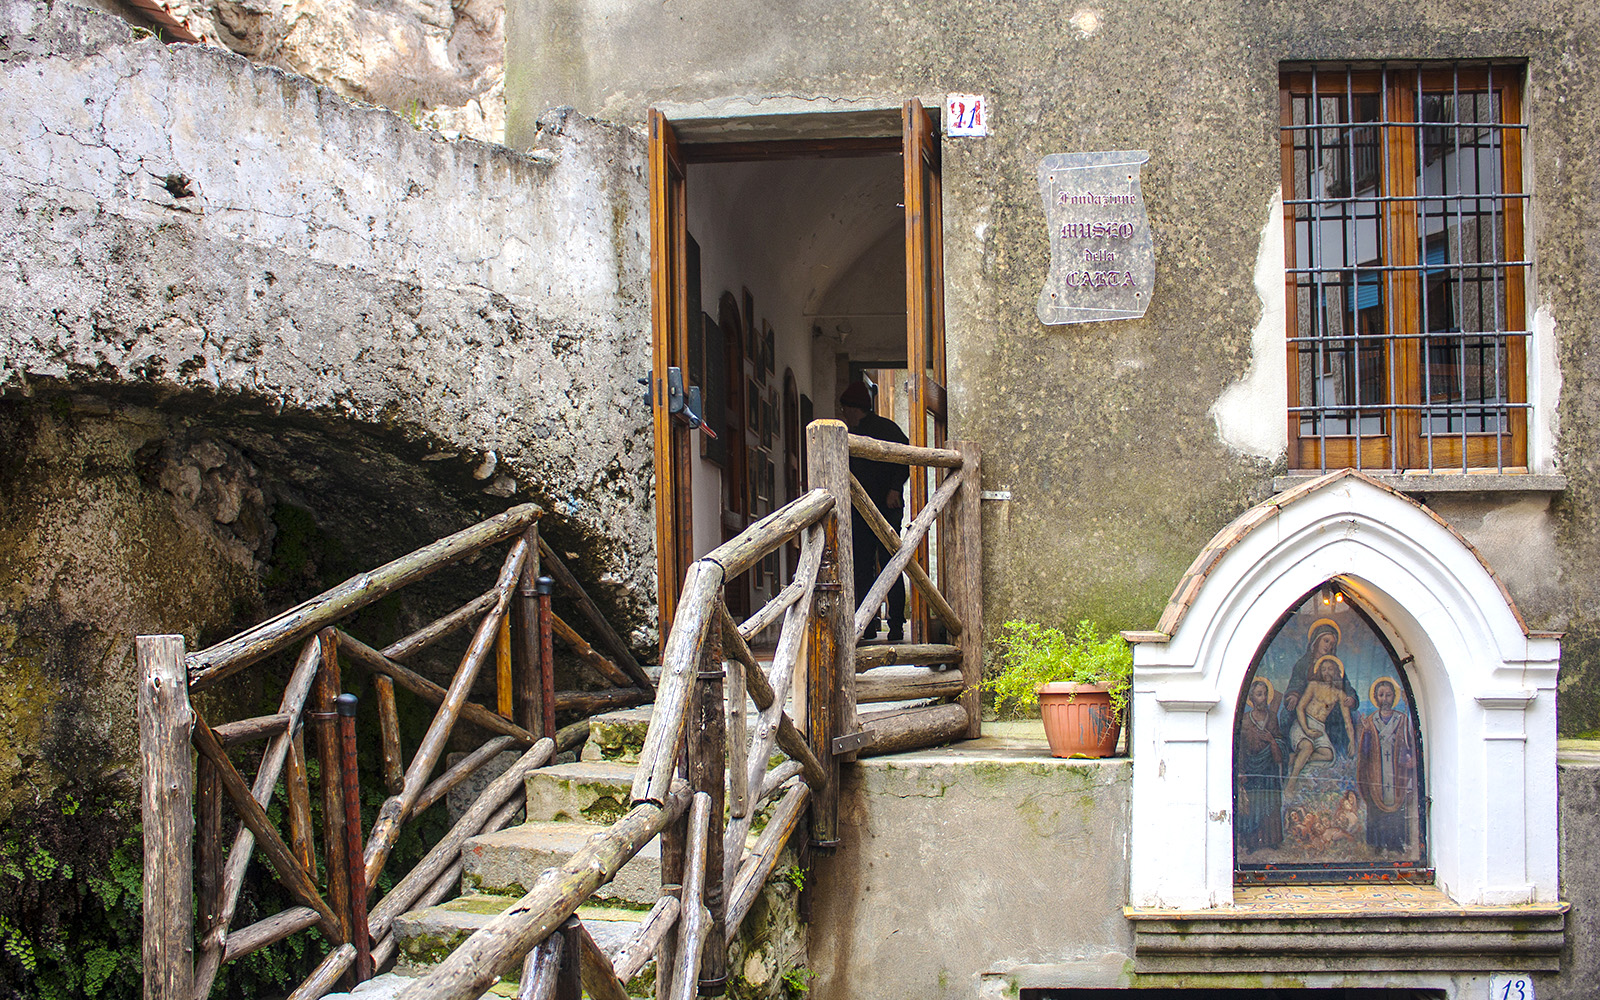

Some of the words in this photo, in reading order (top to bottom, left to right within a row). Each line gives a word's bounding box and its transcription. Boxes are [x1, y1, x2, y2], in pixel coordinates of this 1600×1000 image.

[1056, 191, 1137, 207] Fondazione
[1060, 222, 1134, 239] MUSEO
[1085, 249, 1115, 261] della
[1065, 270, 1136, 287] CARTA
[1502, 980, 1526, 1000] 13
